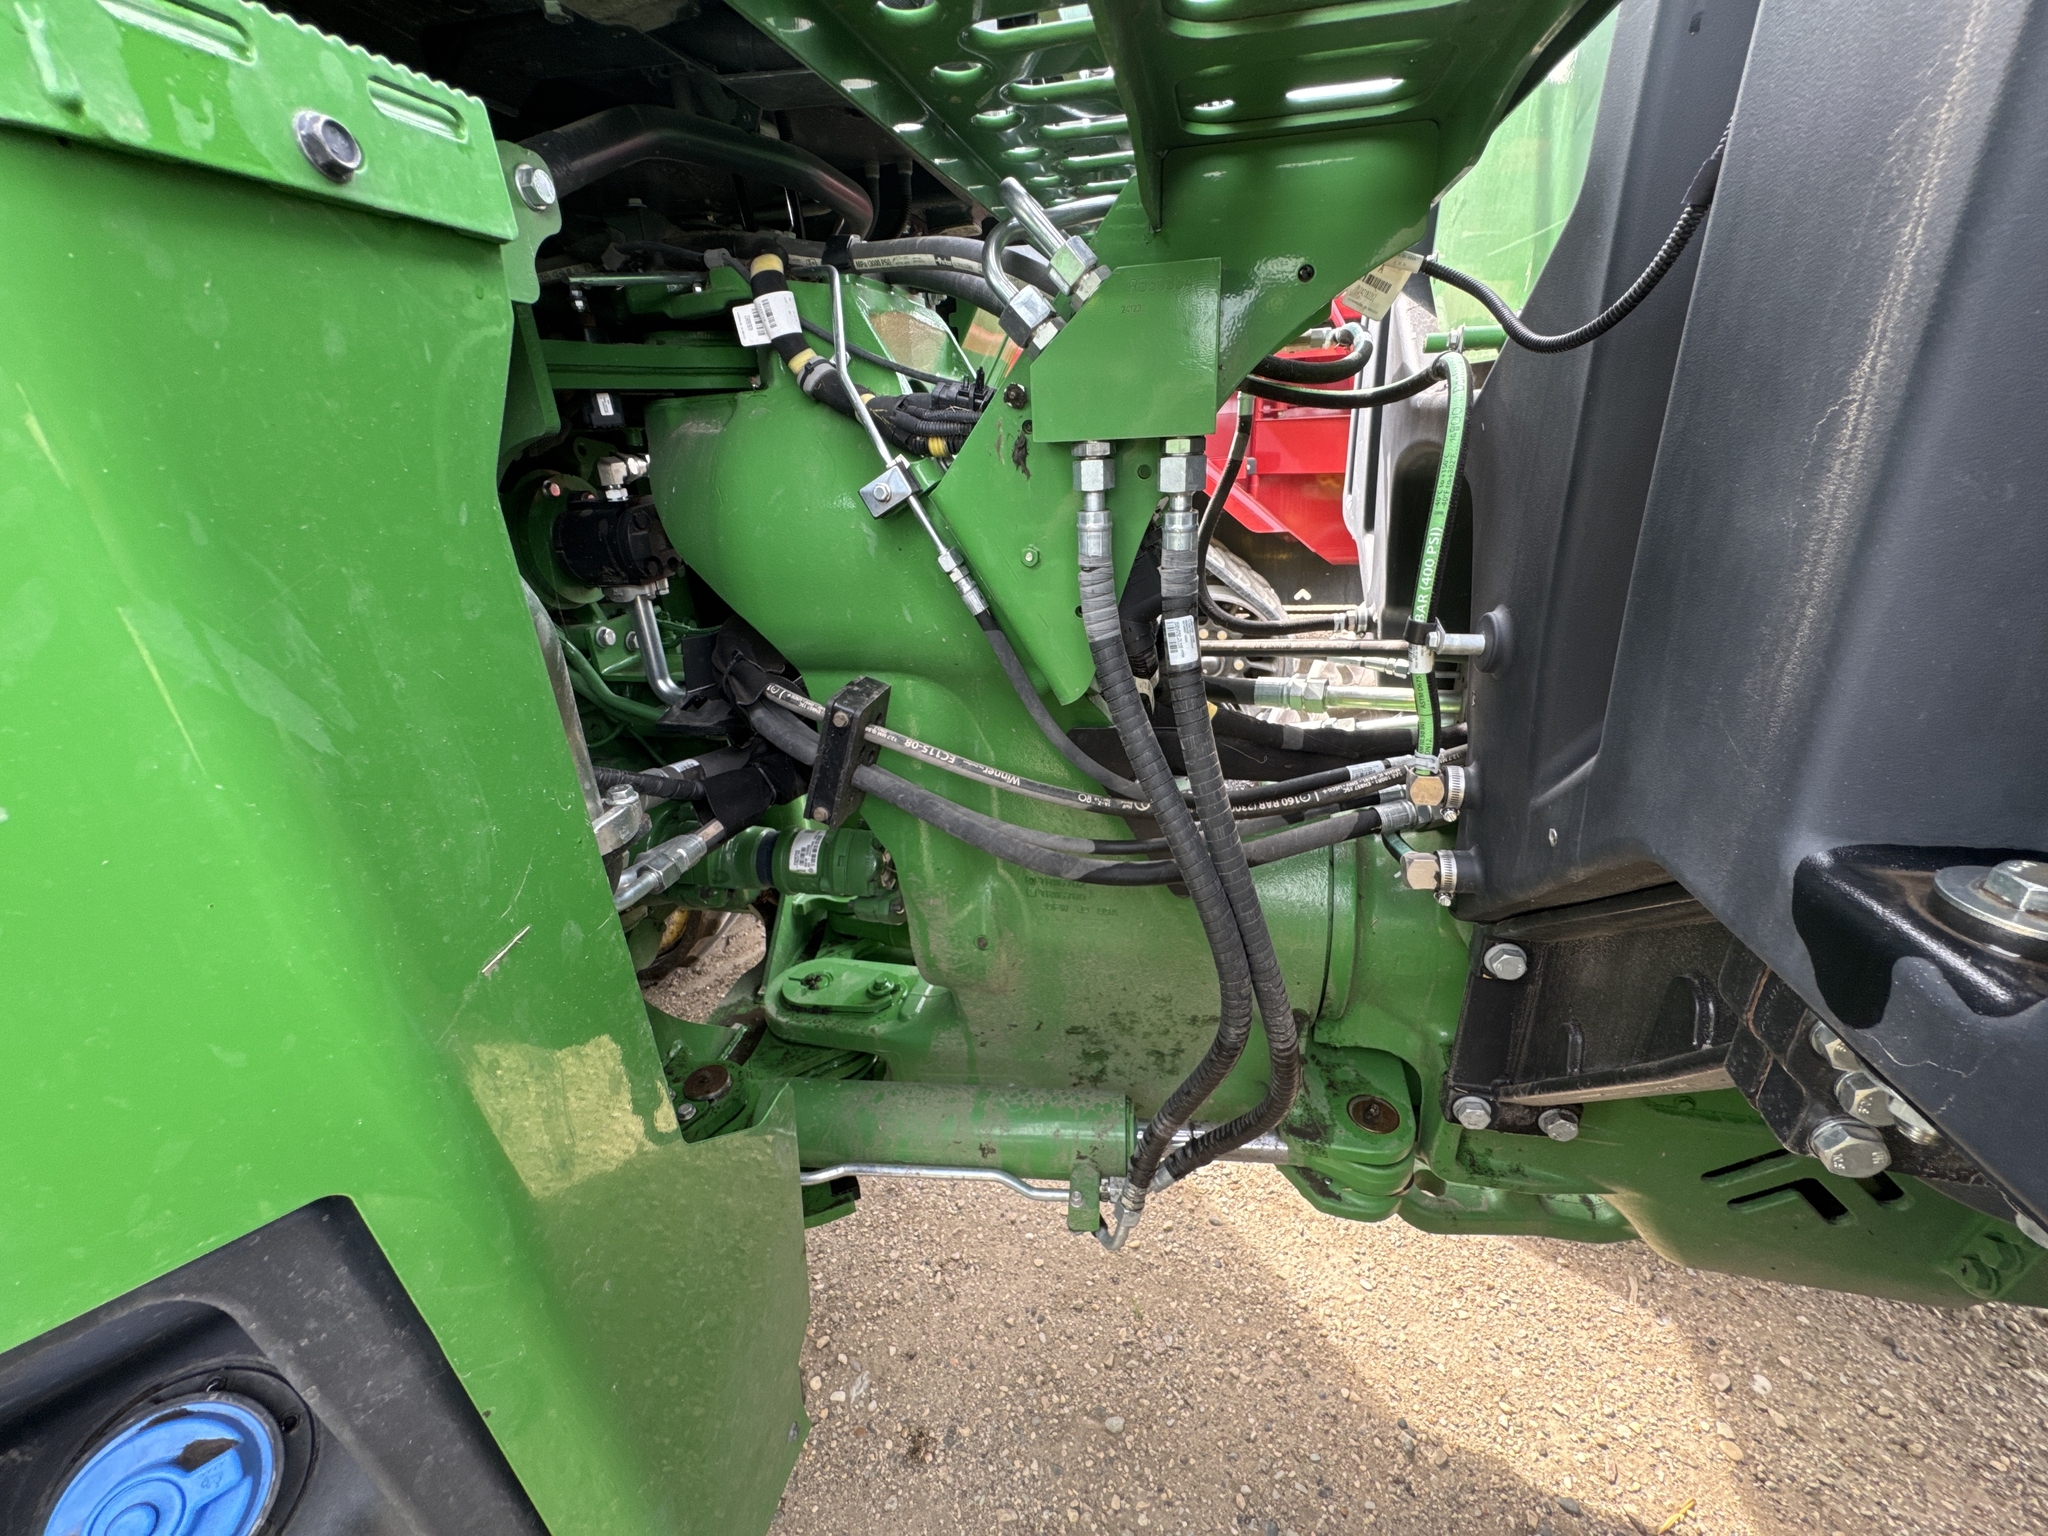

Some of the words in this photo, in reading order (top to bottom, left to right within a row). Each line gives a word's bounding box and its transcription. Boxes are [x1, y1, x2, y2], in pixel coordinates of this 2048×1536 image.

[1427, 526, 1443, 556] PSI)
[1420, 558, 1436, 589] (400
[1414, 594, 1430, 623] BAR
[1419, 693, 1427, 709] ASTM
[904, 738, 956, 765] EC115-08
[982, 767, 1021, 787] Winner
[1258, 799, 1281, 810] BAR
[1281, 795, 1301, 808] 160
